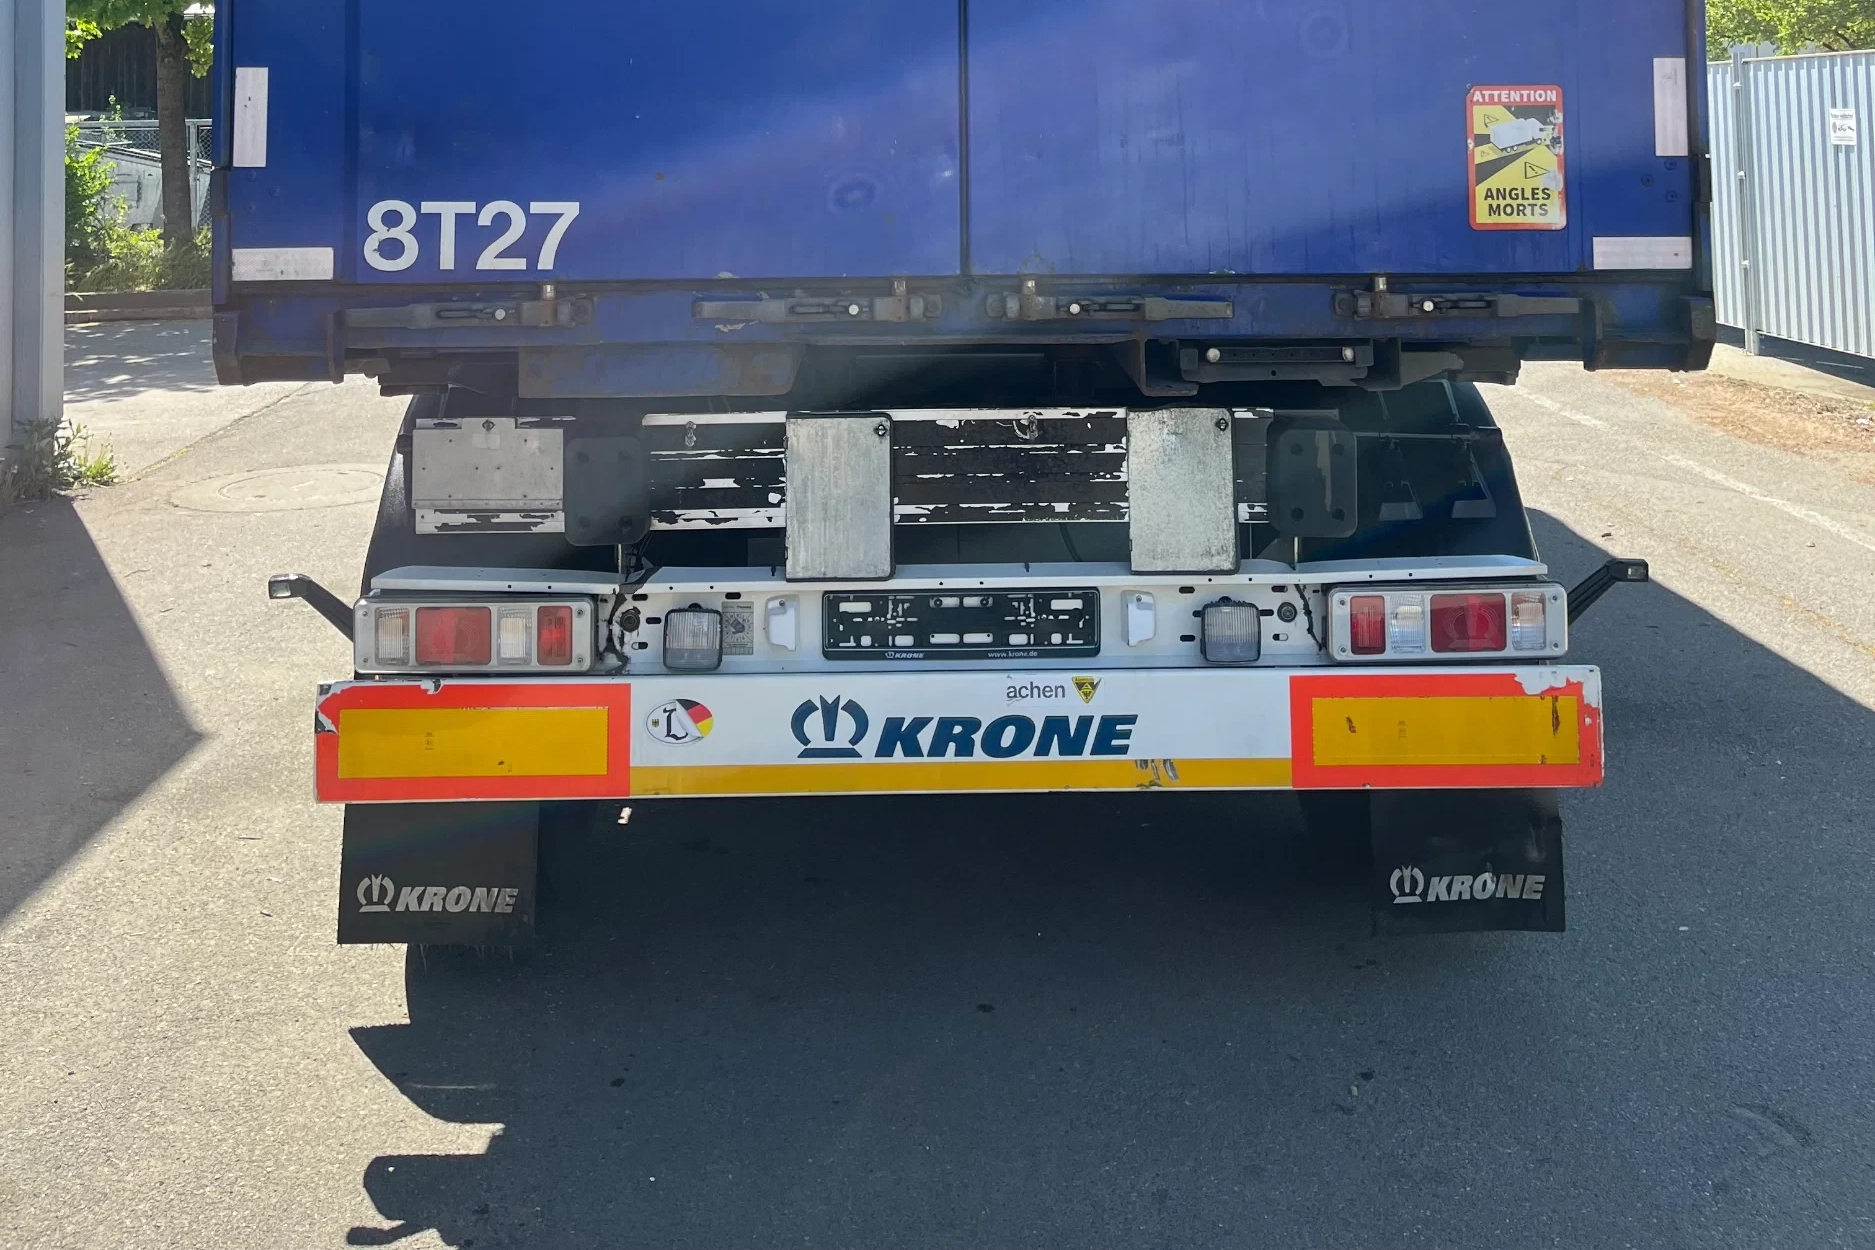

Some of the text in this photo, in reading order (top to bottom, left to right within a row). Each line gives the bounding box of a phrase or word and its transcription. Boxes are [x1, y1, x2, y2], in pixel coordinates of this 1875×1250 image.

[1473, 90, 1557, 102] ATTENTION
[1484, 187, 1551, 201] ANGLES
[1488, 203, 1549, 217] MORTS
[363, 200, 580, 272] 8T27
[987, 650, 1038, 659] www.krone.de
[874, 713, 1139, 759] KRONE
[1426, 871, 1546, 902] KRONE
[395, 885, 519, 914] KRONE
